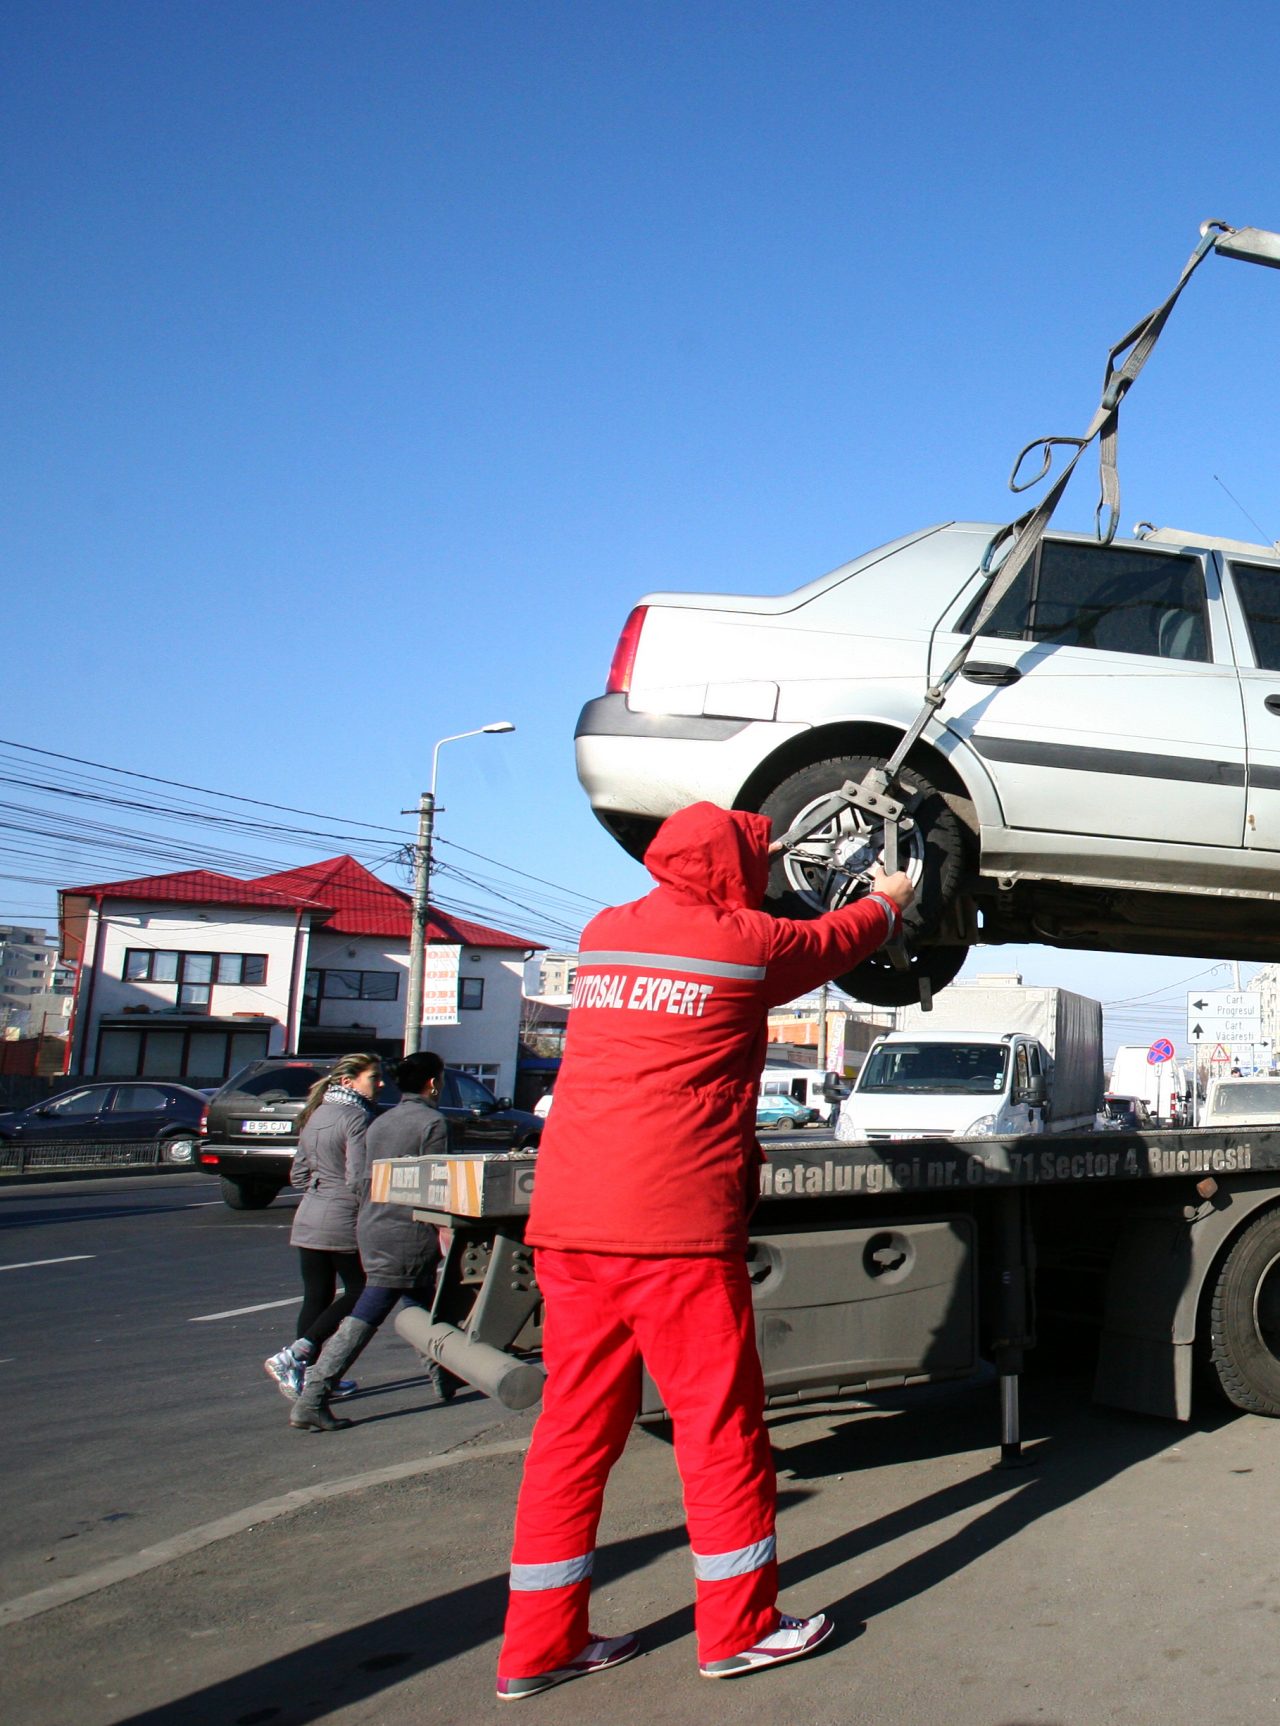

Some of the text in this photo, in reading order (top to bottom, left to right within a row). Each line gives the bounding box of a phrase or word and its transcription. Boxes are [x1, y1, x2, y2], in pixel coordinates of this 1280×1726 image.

[627, 976, 714, 1017] EXPERT
[1217, 1005, 1255, 1017] Progresul
[249, 1121, 256, 1130] B
[258, 1122, 268, 1130] 95
[927, 1160, 960, 1187] nr.
[1149, 1144, 1251, 1174] Bucuresti
